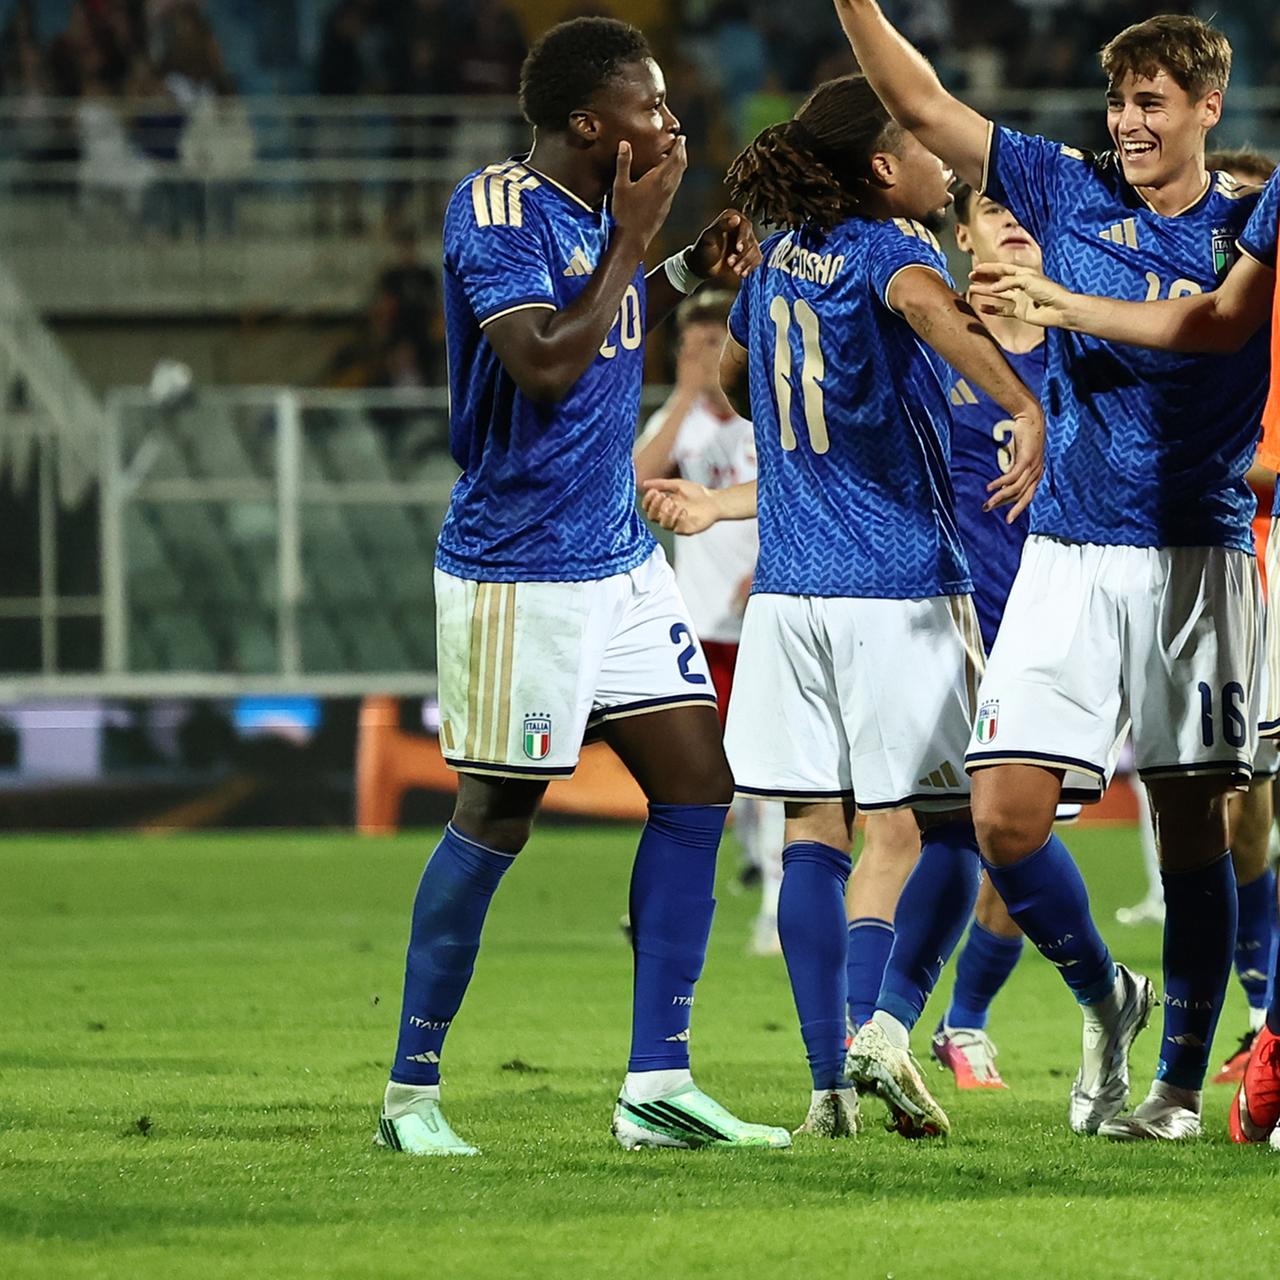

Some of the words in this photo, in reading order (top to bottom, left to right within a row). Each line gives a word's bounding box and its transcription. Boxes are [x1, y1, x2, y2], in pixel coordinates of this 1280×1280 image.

[769, 295, 830, 455] 11
[669, 622, 707, 684] 2
[526, 722, 548, 731] ITALIA
[1198, 681, 1246, 748] 16
[672, 996, 695, 1006] ITA
